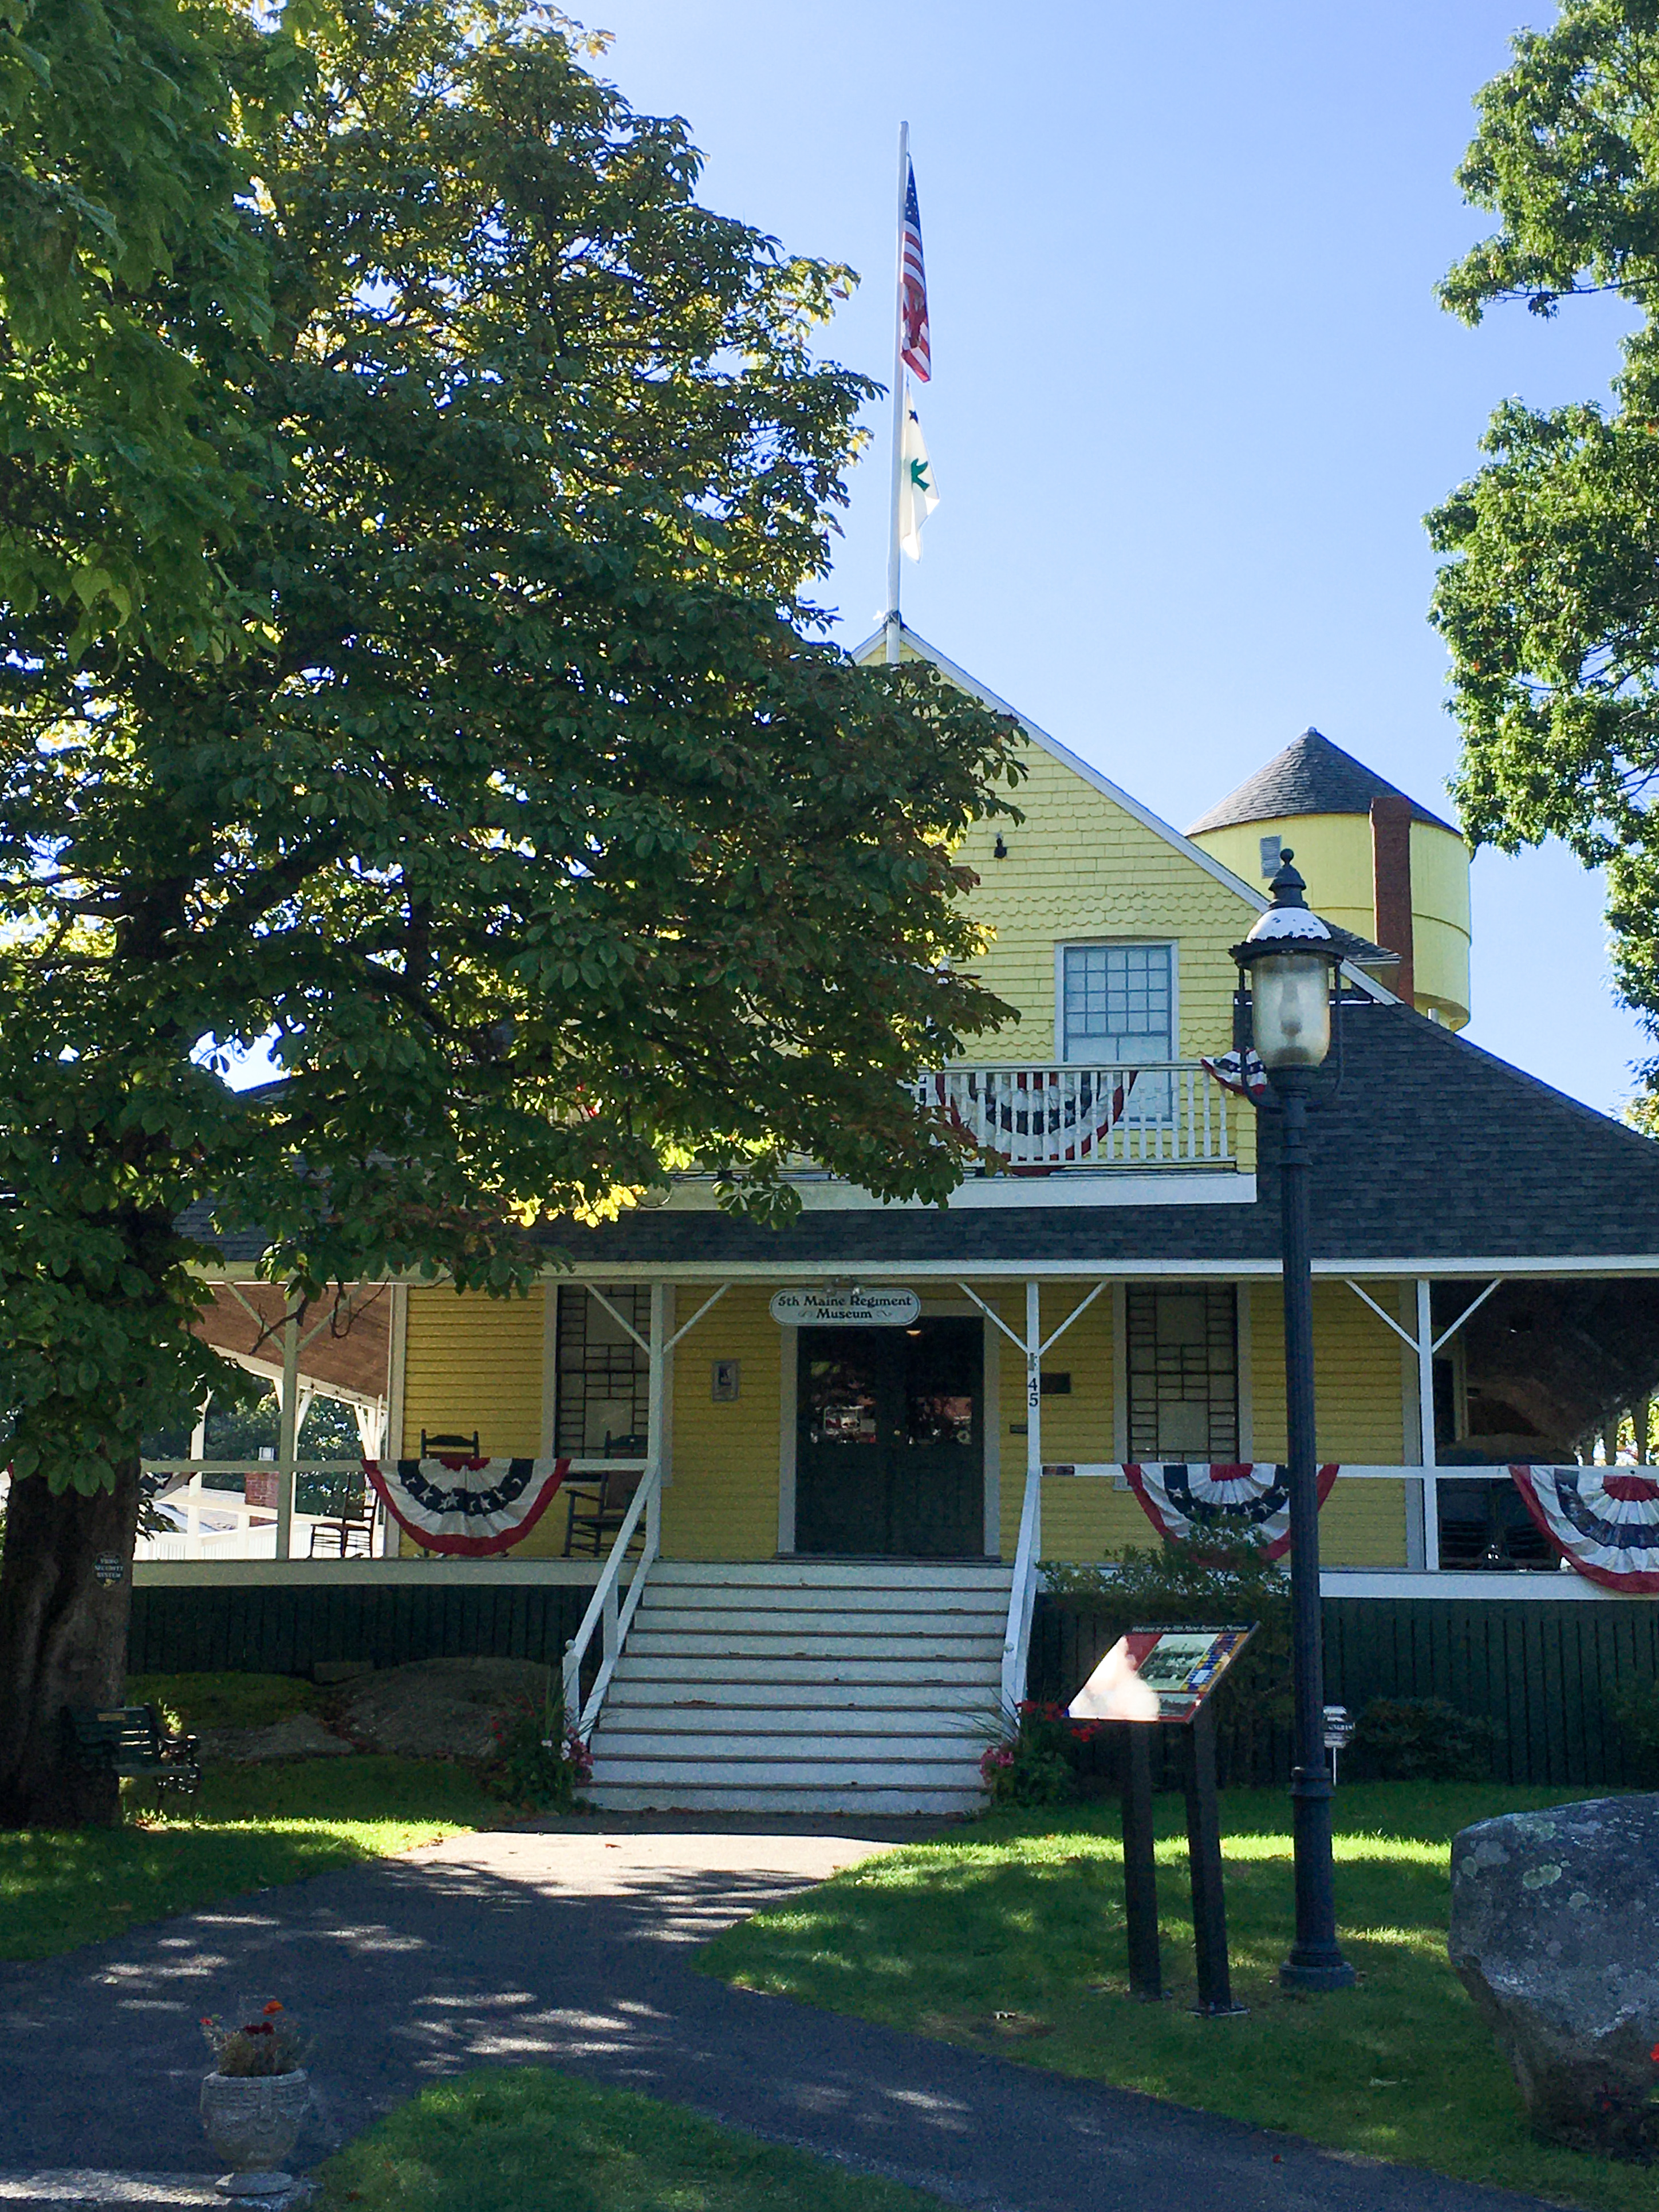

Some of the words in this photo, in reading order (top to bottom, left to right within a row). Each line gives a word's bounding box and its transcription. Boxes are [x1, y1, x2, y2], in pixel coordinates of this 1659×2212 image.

[778, 1296, 799, 1306] 5th
[803, 1295, 846, 1306] Maine
[850, 1295, 912, 1308] Regiment
[816, 1308, 873, 1319] Museum
[1028, 1378, 1038, 1407] 45
